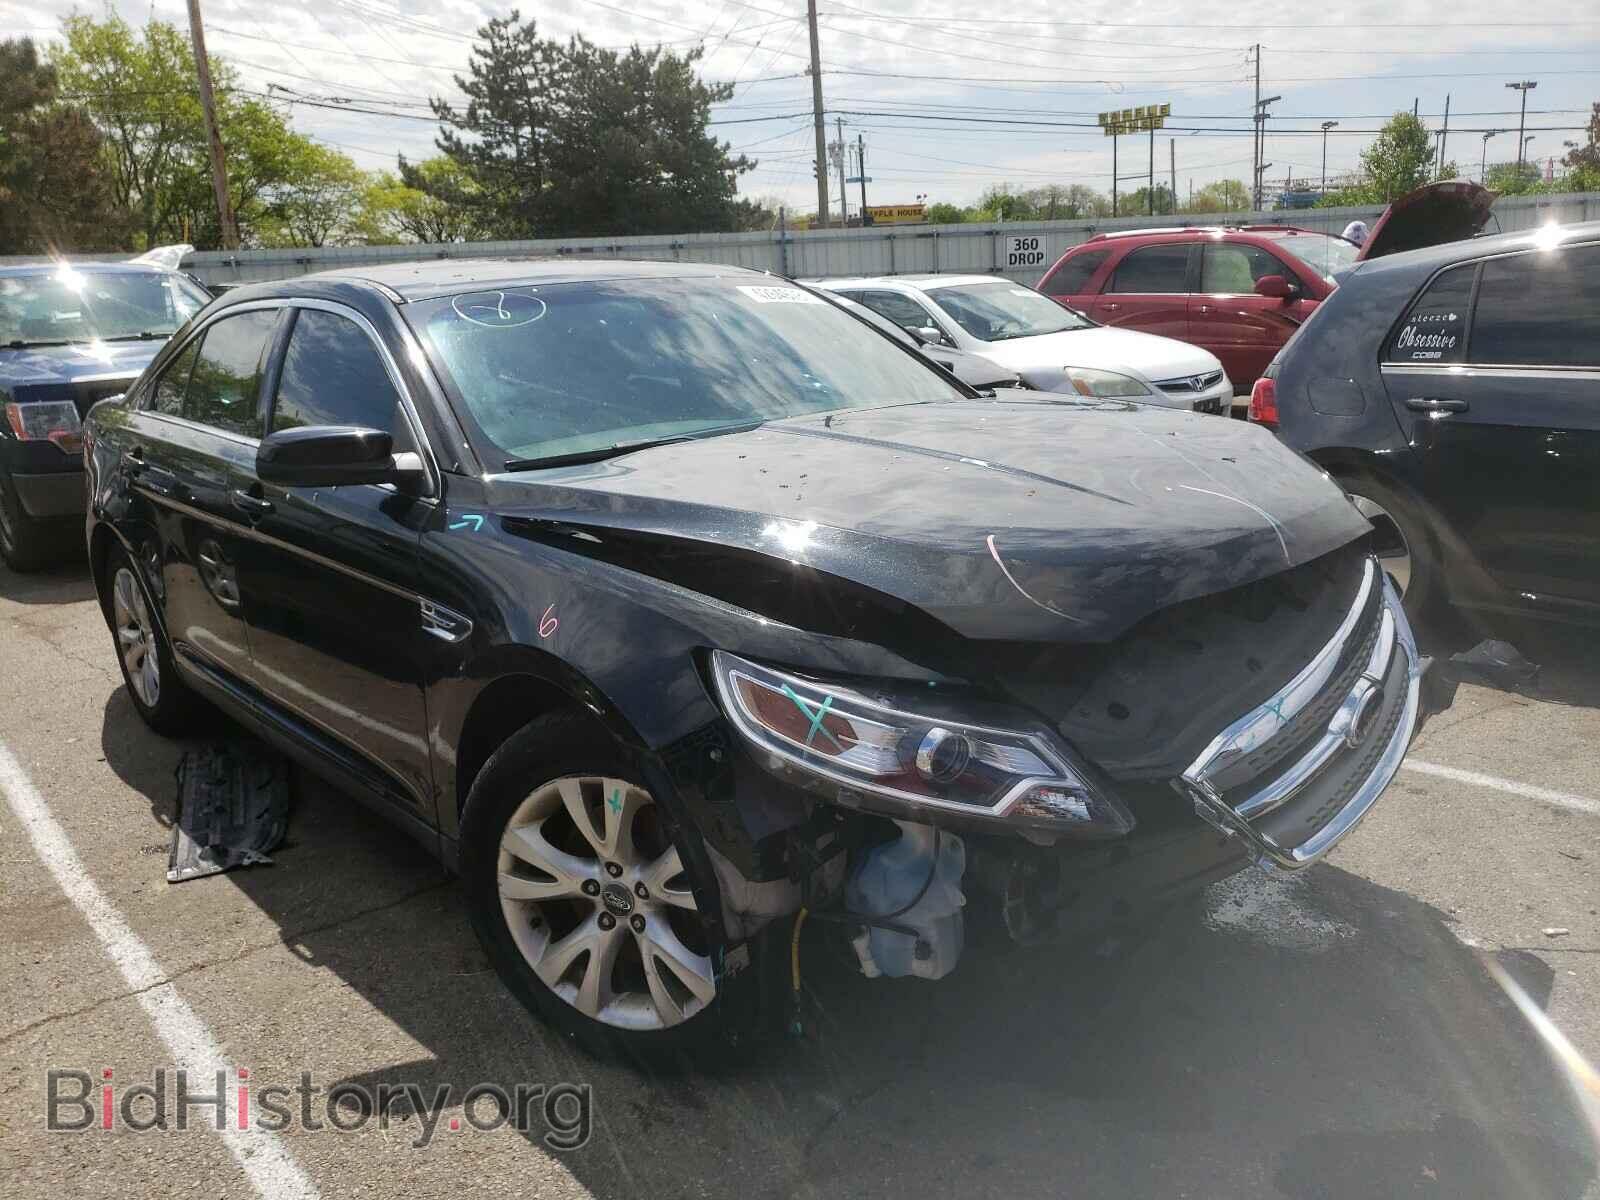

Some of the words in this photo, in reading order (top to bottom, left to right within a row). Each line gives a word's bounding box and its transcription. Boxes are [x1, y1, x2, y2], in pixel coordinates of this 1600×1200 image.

[1014, 238, 1039, 251] 360
[1009, 252, 1044, 265] DROP
[1397, 325, 1456, 348] Obsessive
[539, 603, 558, 638] 6
